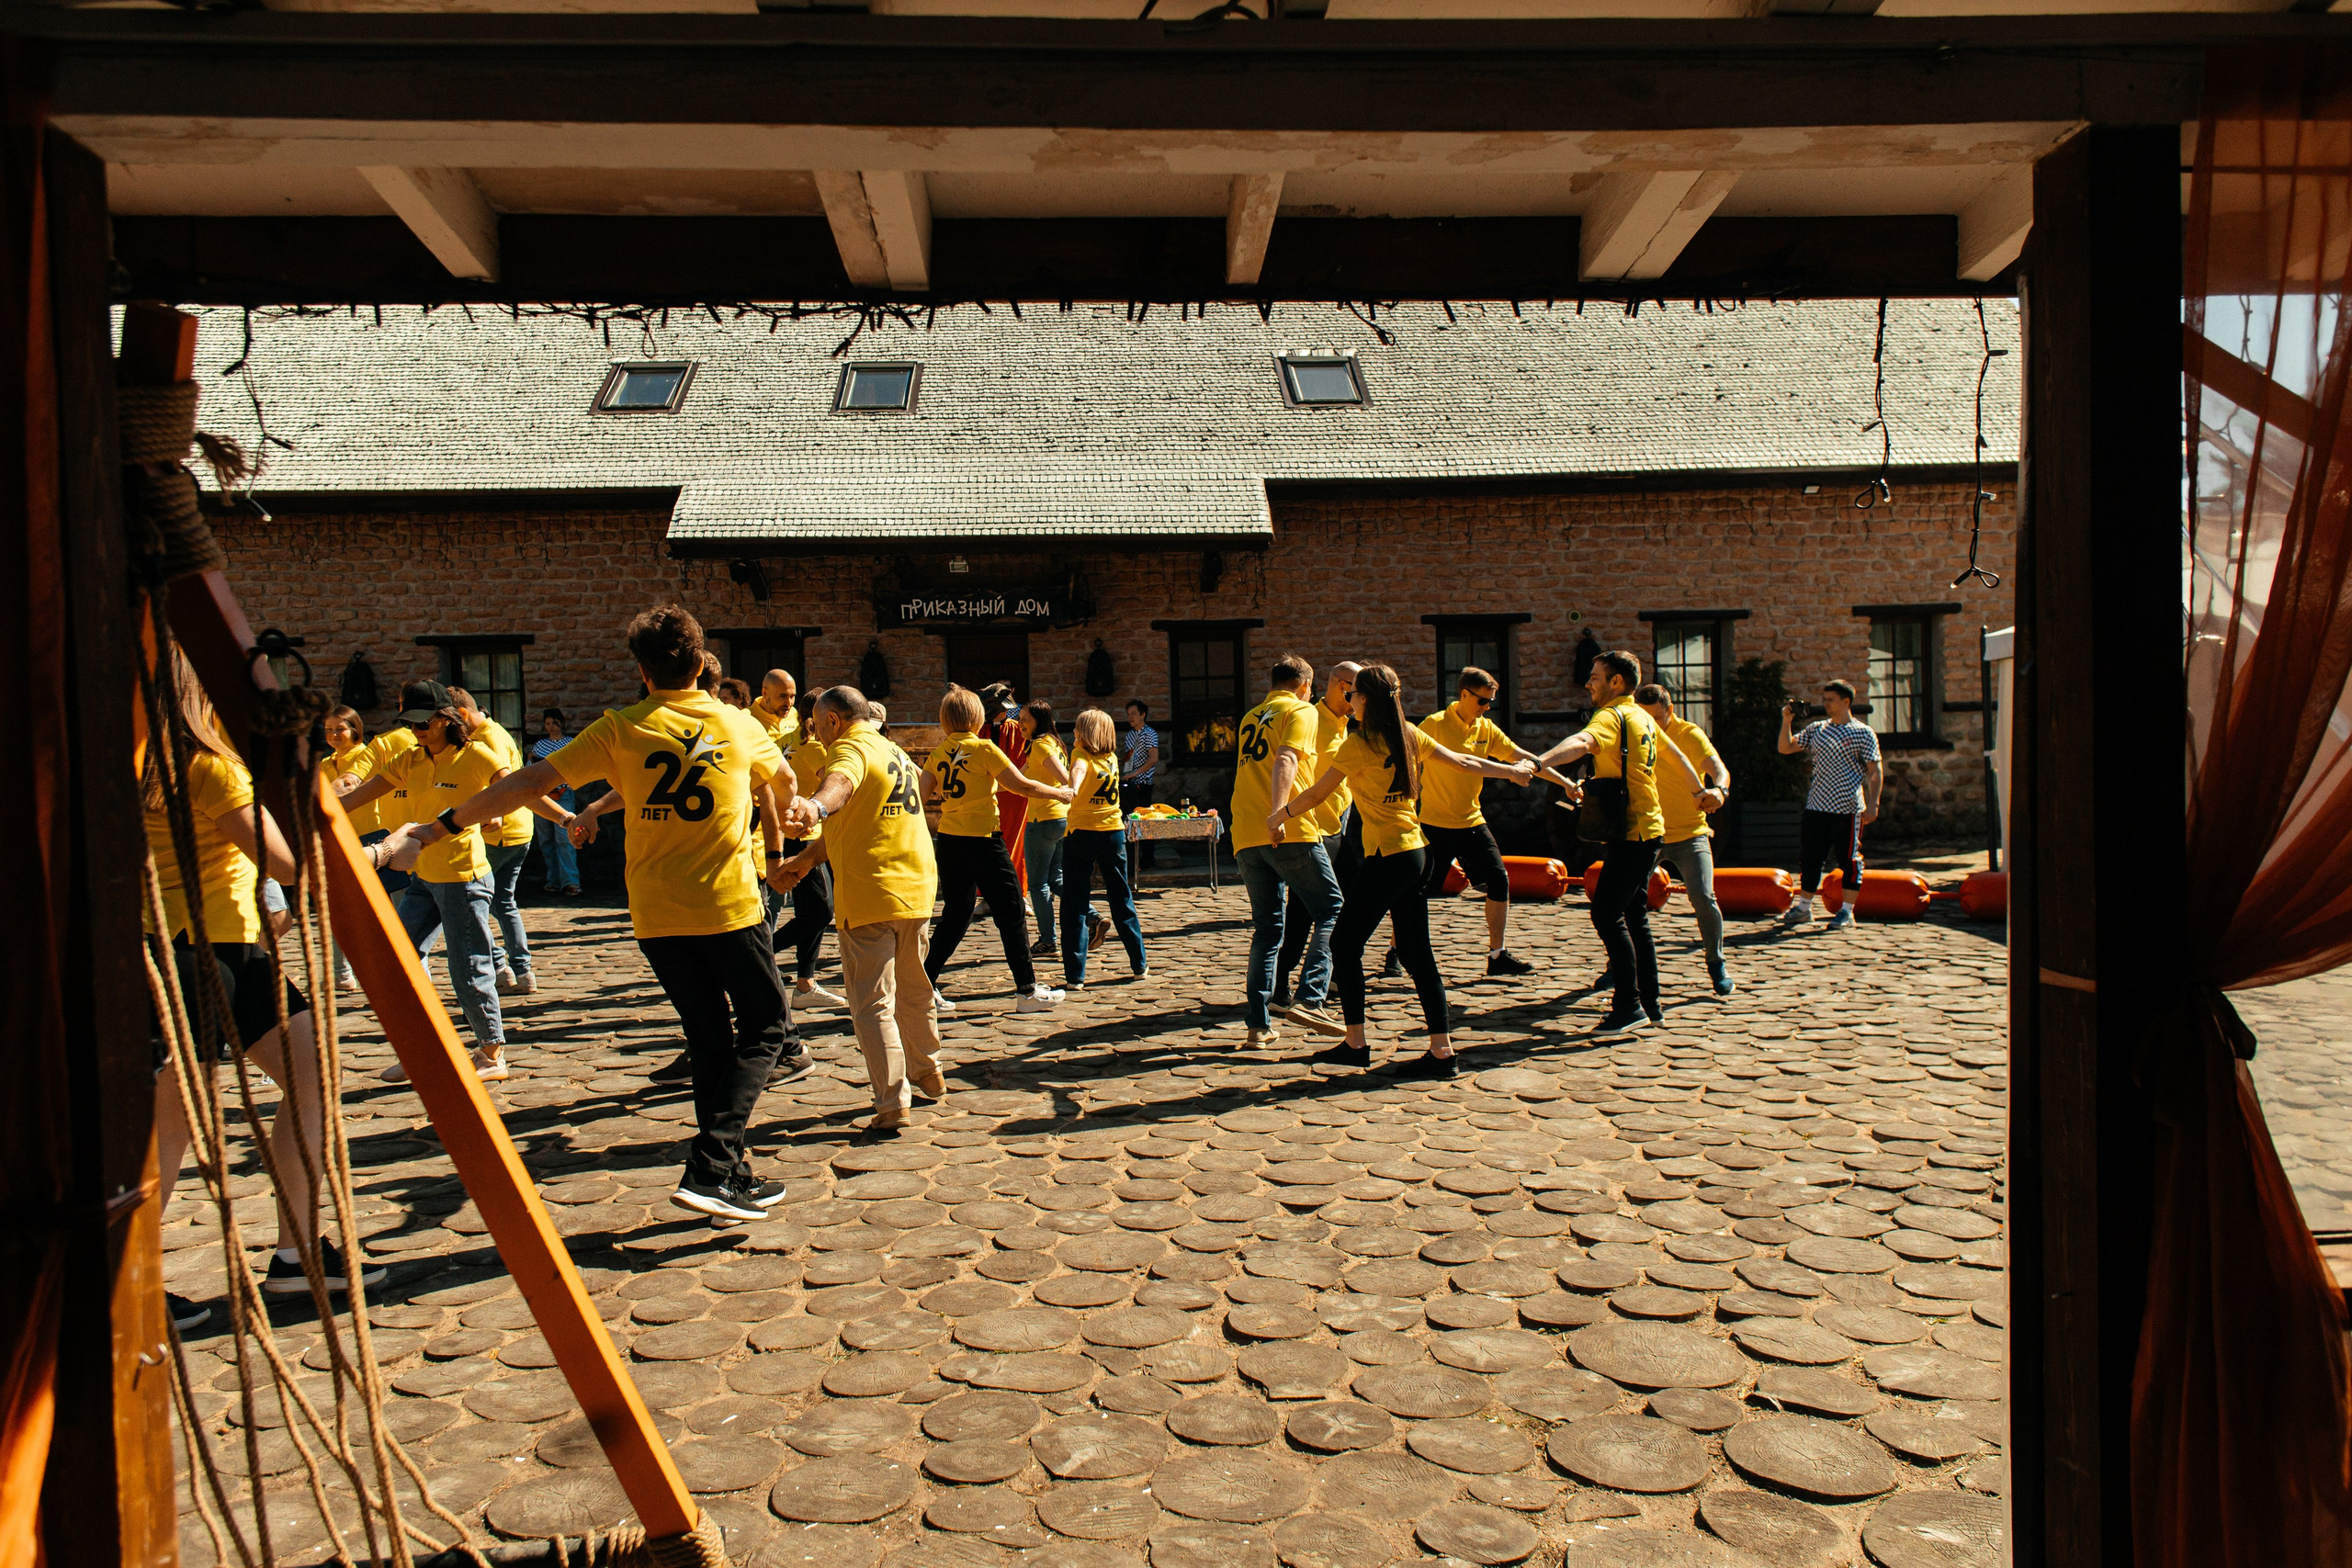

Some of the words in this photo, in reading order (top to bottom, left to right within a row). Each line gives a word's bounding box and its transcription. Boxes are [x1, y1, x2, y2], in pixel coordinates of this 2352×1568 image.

[901, 594, 1006, 620] ПРИКАЗНЫЙ
[1014, 598, 1050, 616] ДОМ
[1240, 723, 1269, 762] 26
[1641, 733, 1657, 767] 2
[394, 789, 408, 799] ЛЕ
[644, 750, 715, 822] 26
[887, 761, 921, 816] 26
[936, 761, 967, 799] 26
[1093, 770, 1118, 806] 26
[640, 807, 672, 821] ЛЕТ
[880, 806, 902, 817] ЛЕТ
[1089, 797, 1105, 806] ЛЕТ
[1382, 794, 1405, 804] ЛЕТ
